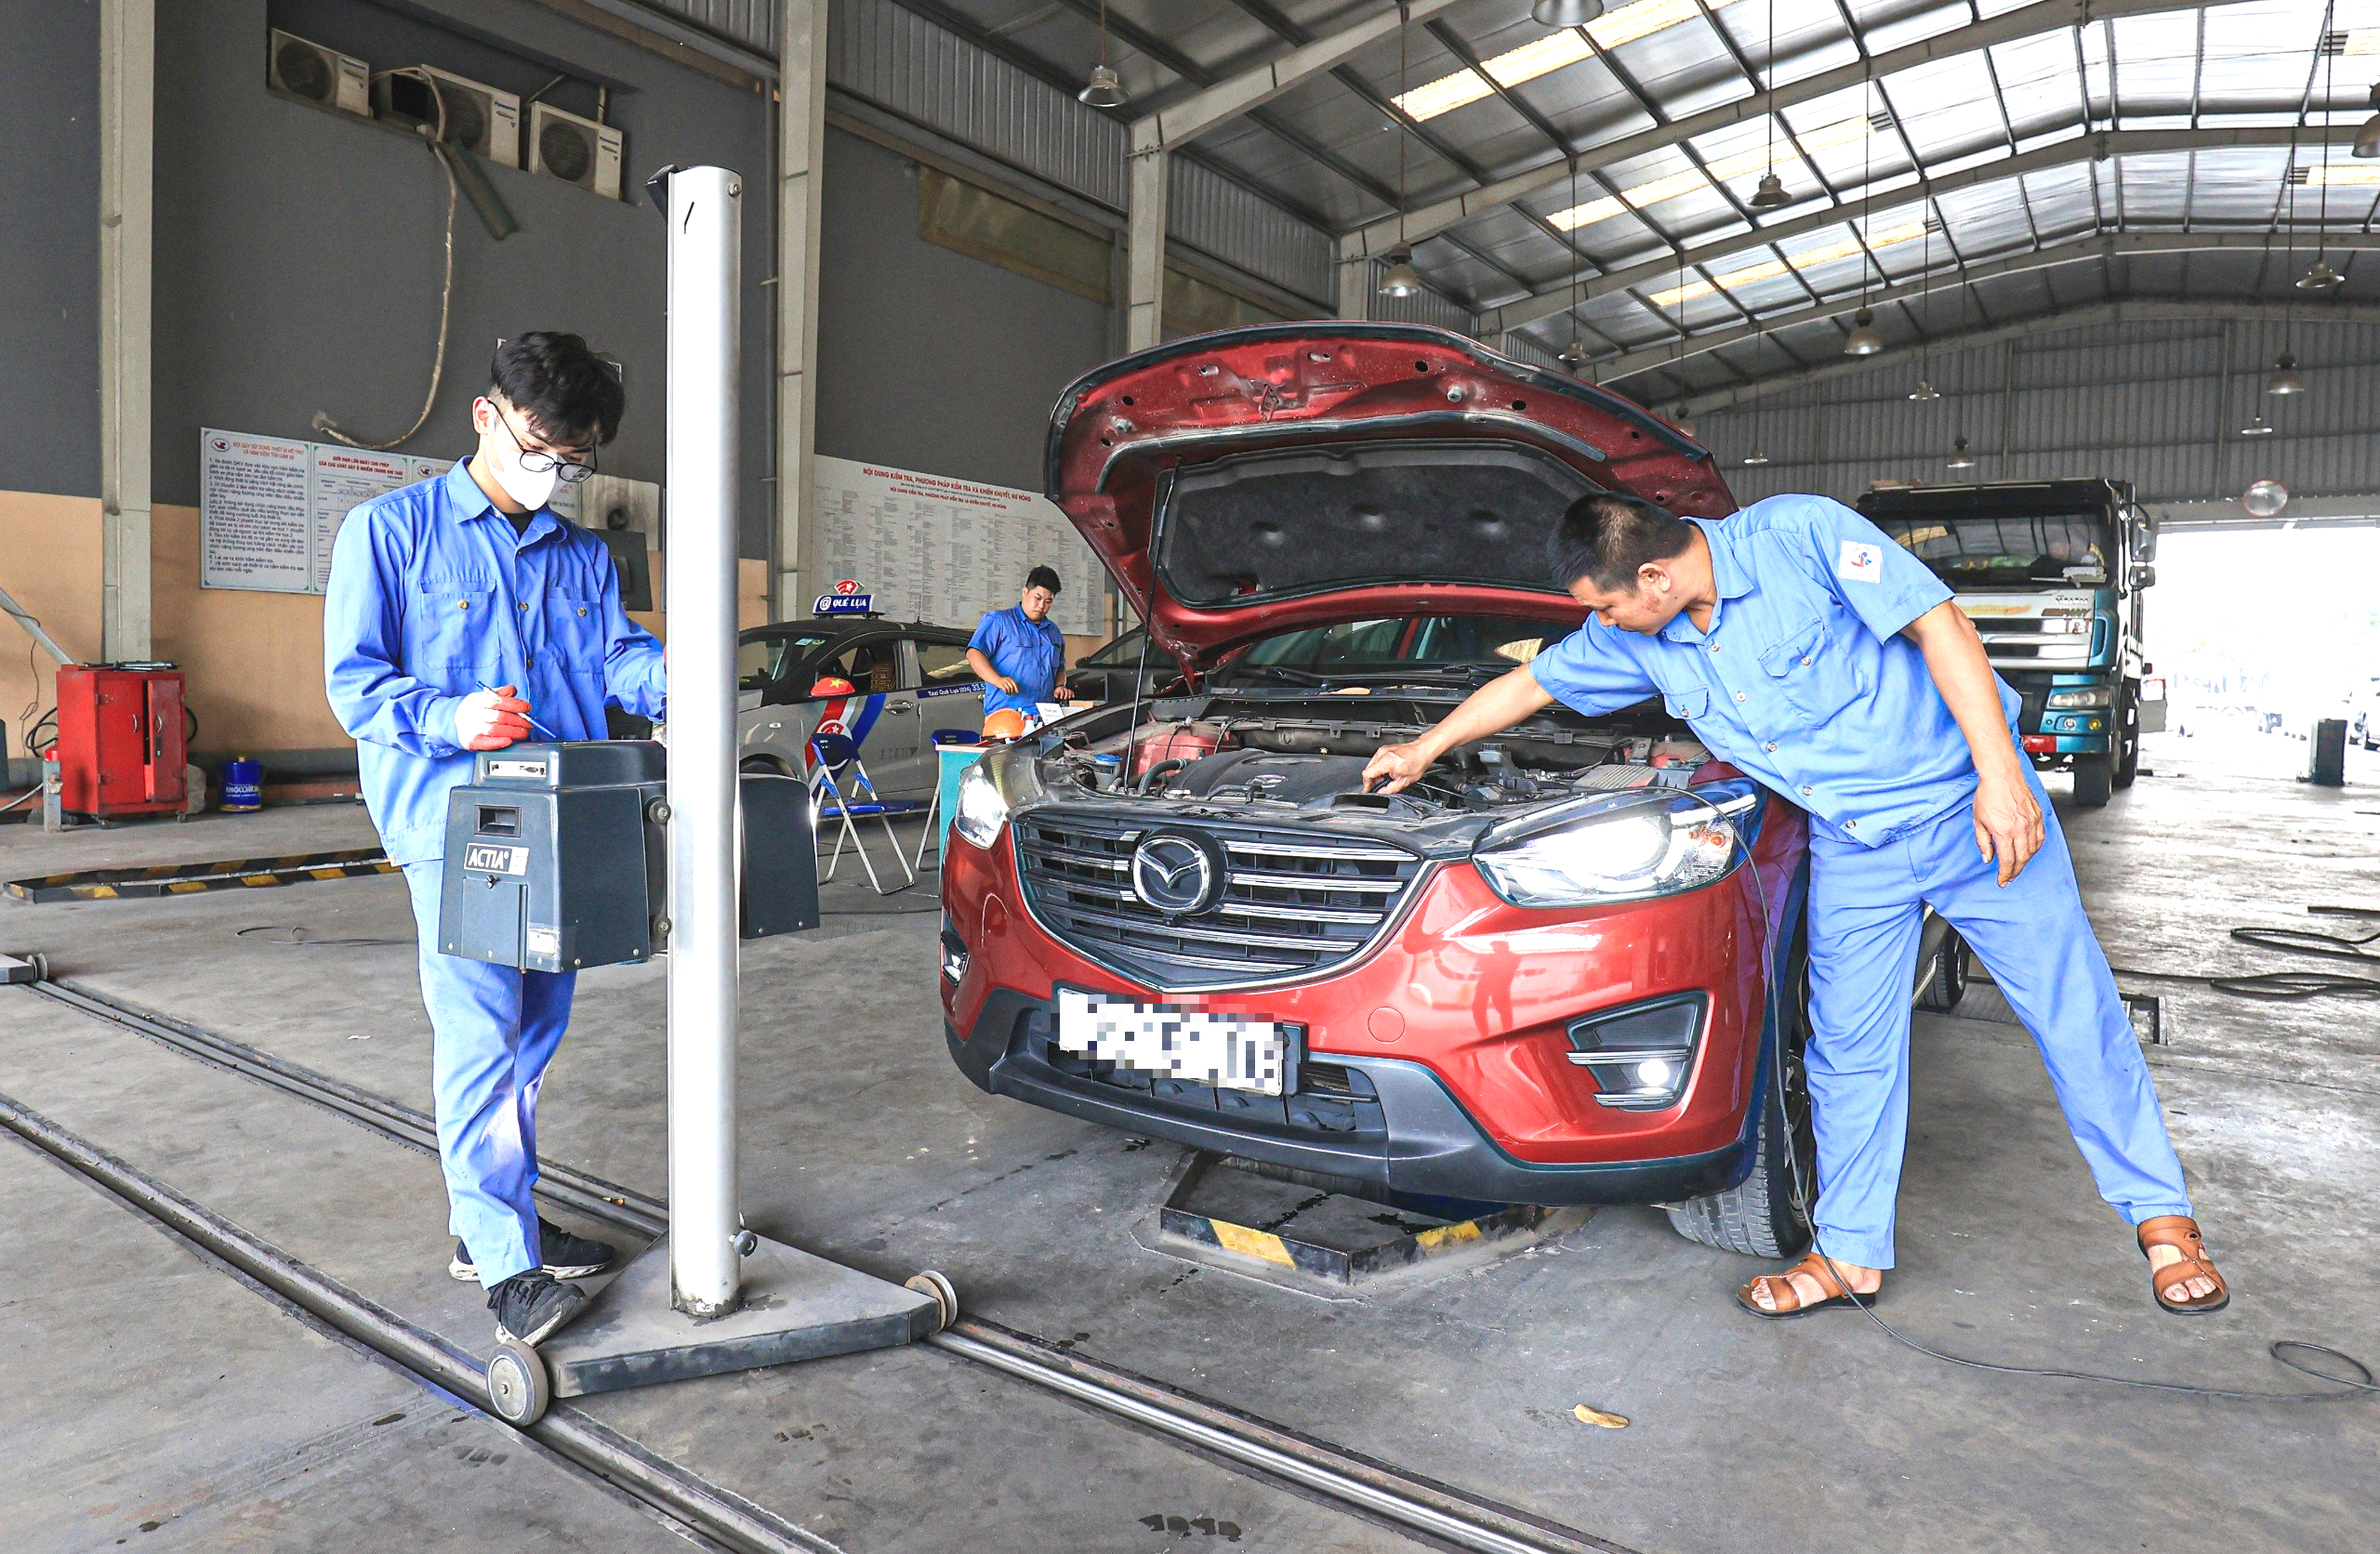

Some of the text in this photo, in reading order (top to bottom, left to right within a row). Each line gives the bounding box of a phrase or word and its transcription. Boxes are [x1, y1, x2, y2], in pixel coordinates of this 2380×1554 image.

[863, 467, 873, 477] NỘI
[874, 469, 890, 478] DUNG
[890, 469, 902, 481] KIỂM
[915, 476, 936, 486] PHƯƠNG
[937, 479, 949, 488] PHÁP
[468, 848, 504, 869] ACTIA
